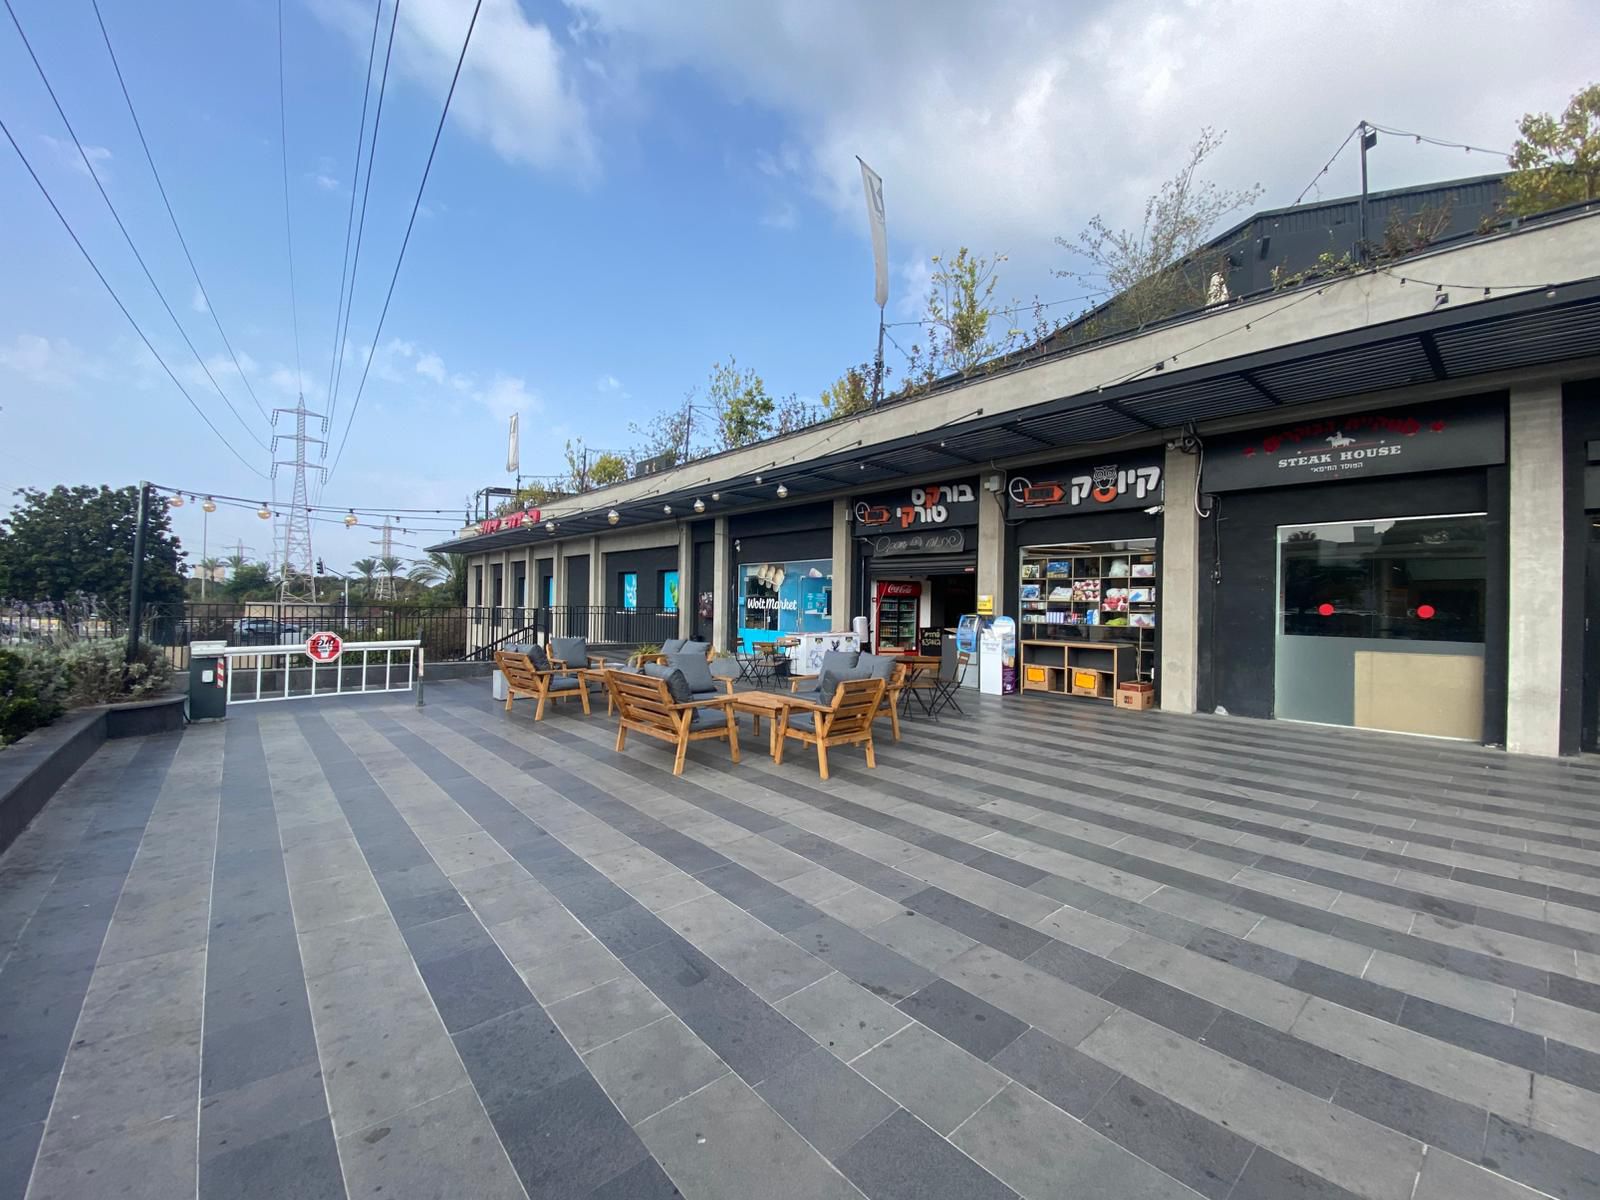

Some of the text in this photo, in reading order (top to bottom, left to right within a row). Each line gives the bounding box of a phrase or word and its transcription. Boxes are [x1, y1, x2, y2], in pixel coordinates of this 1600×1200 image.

[1278, 445, 1401, 468] STEAK HOUSE
[1340, 462, 1363, 470] המוסד
[911, 484, 975, 509] בורקס
[1071, 465, 1161, 505] קיוסק
[896, 505, 948, 529] טורקי
[747, 598, 766, 609] Wolt
[766, 598, 797, 610] Market
